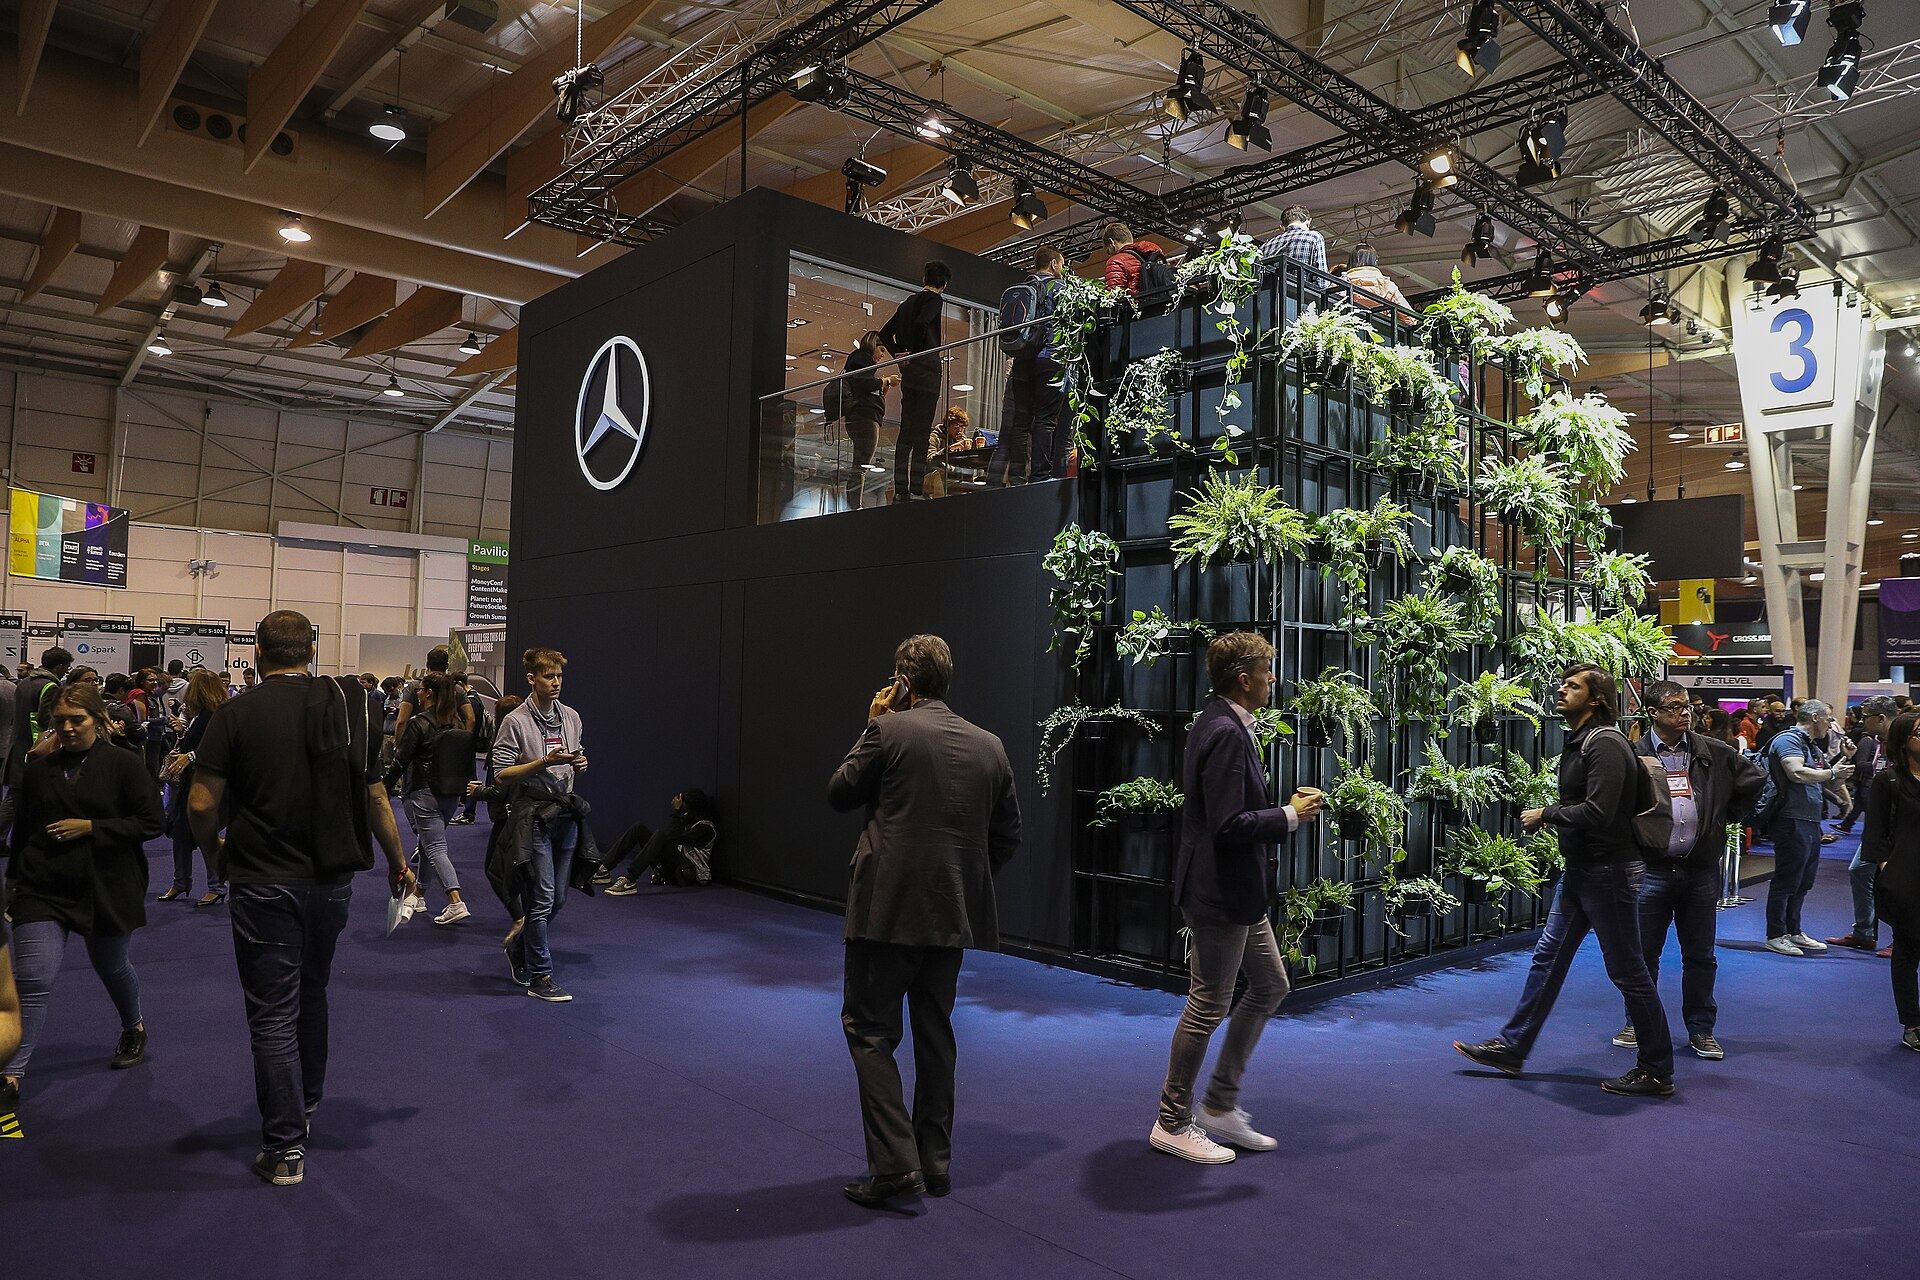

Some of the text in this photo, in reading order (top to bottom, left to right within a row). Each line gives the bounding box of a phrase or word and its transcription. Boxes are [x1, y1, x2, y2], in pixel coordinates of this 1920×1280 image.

[1770, 308, 1818, 393] 3
[473, 544, 508, 557] Pavilio
[471, 564, 490, 572] Stages
[471, 578, 503, 587] MoneyConf
[469, 612, 491, 620] Growth
[91, 645, 116, 654] Spark
[468, 643, 494, 653] EVERYWHERE
